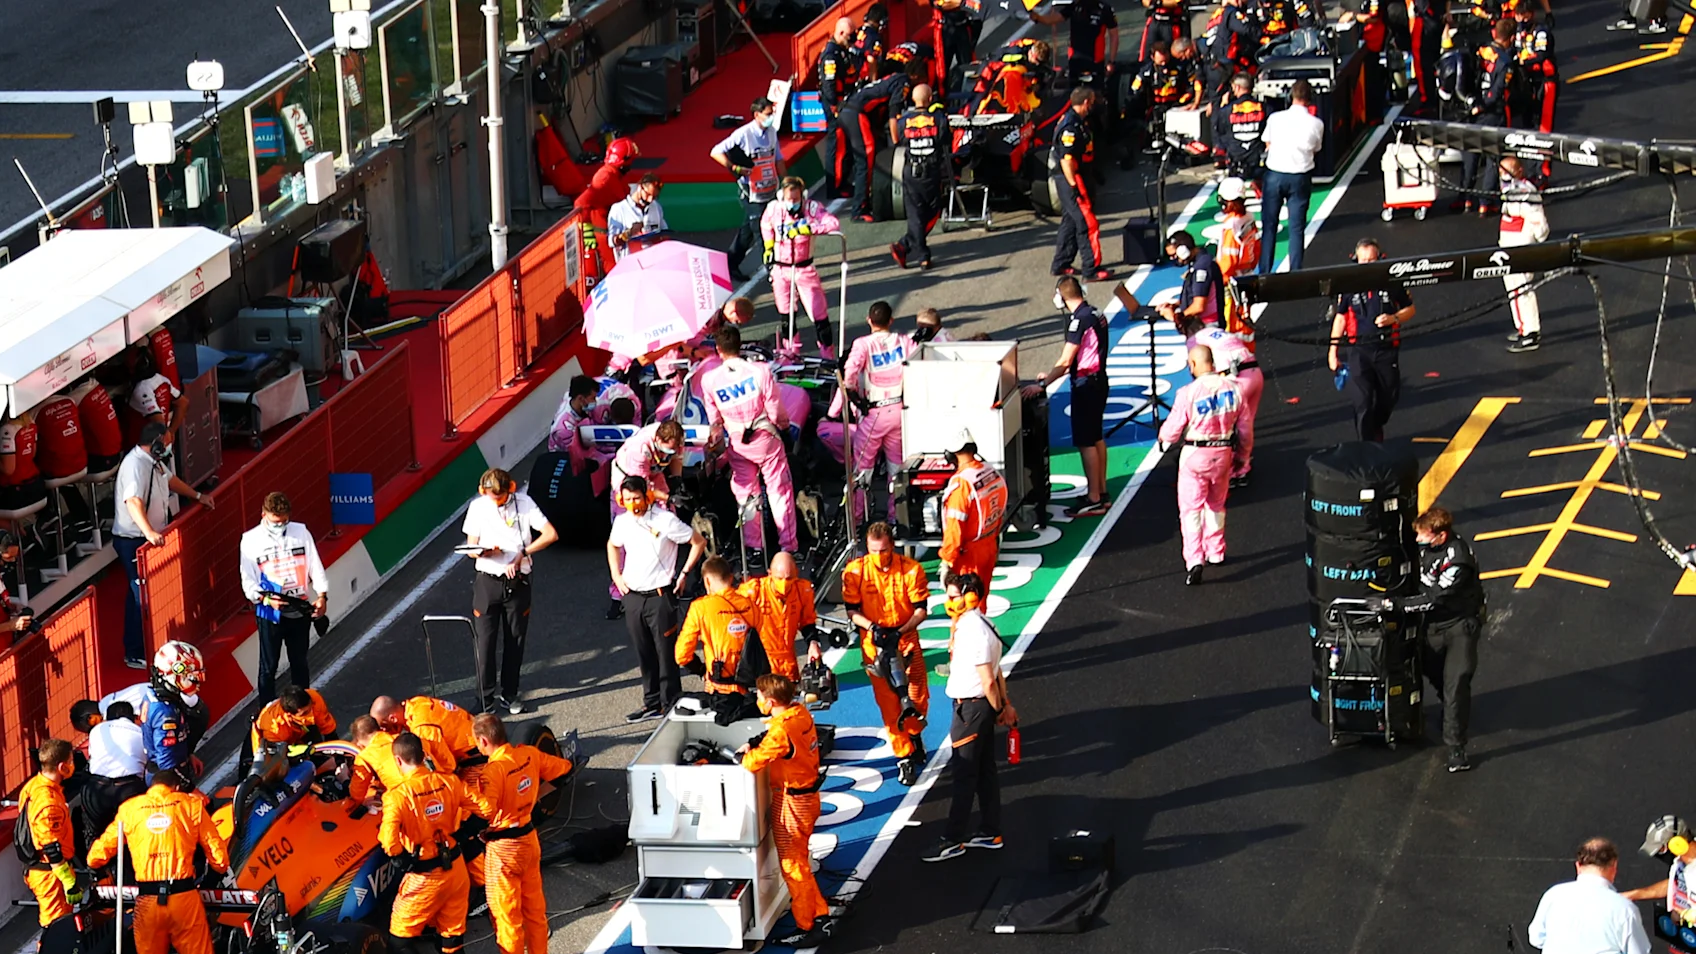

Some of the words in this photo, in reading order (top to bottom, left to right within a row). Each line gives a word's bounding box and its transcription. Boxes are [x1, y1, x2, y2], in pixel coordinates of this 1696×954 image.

[1389, 261, 1417, 278] Alfa
[1415, 258, 1454, 272] Romeo
[1475, 267, 1509, 278] ORLEN
[1403, 277, 1439, 287] RACING
[871, 346, 904, 368] BWT
[716, 376, 757, 403] BWT
[1196, 391, 1235, 415] BWT
[1311, 499, 1328, 512] LEFT
[1330, 503, 1364, 517] FRONT
[1323, 565, 1348, 580] LEFT
[425, 805, 444, 816] Gulf
[257, 836, 295, 871] VELO
[96, 885, 140, 901] HUSK
